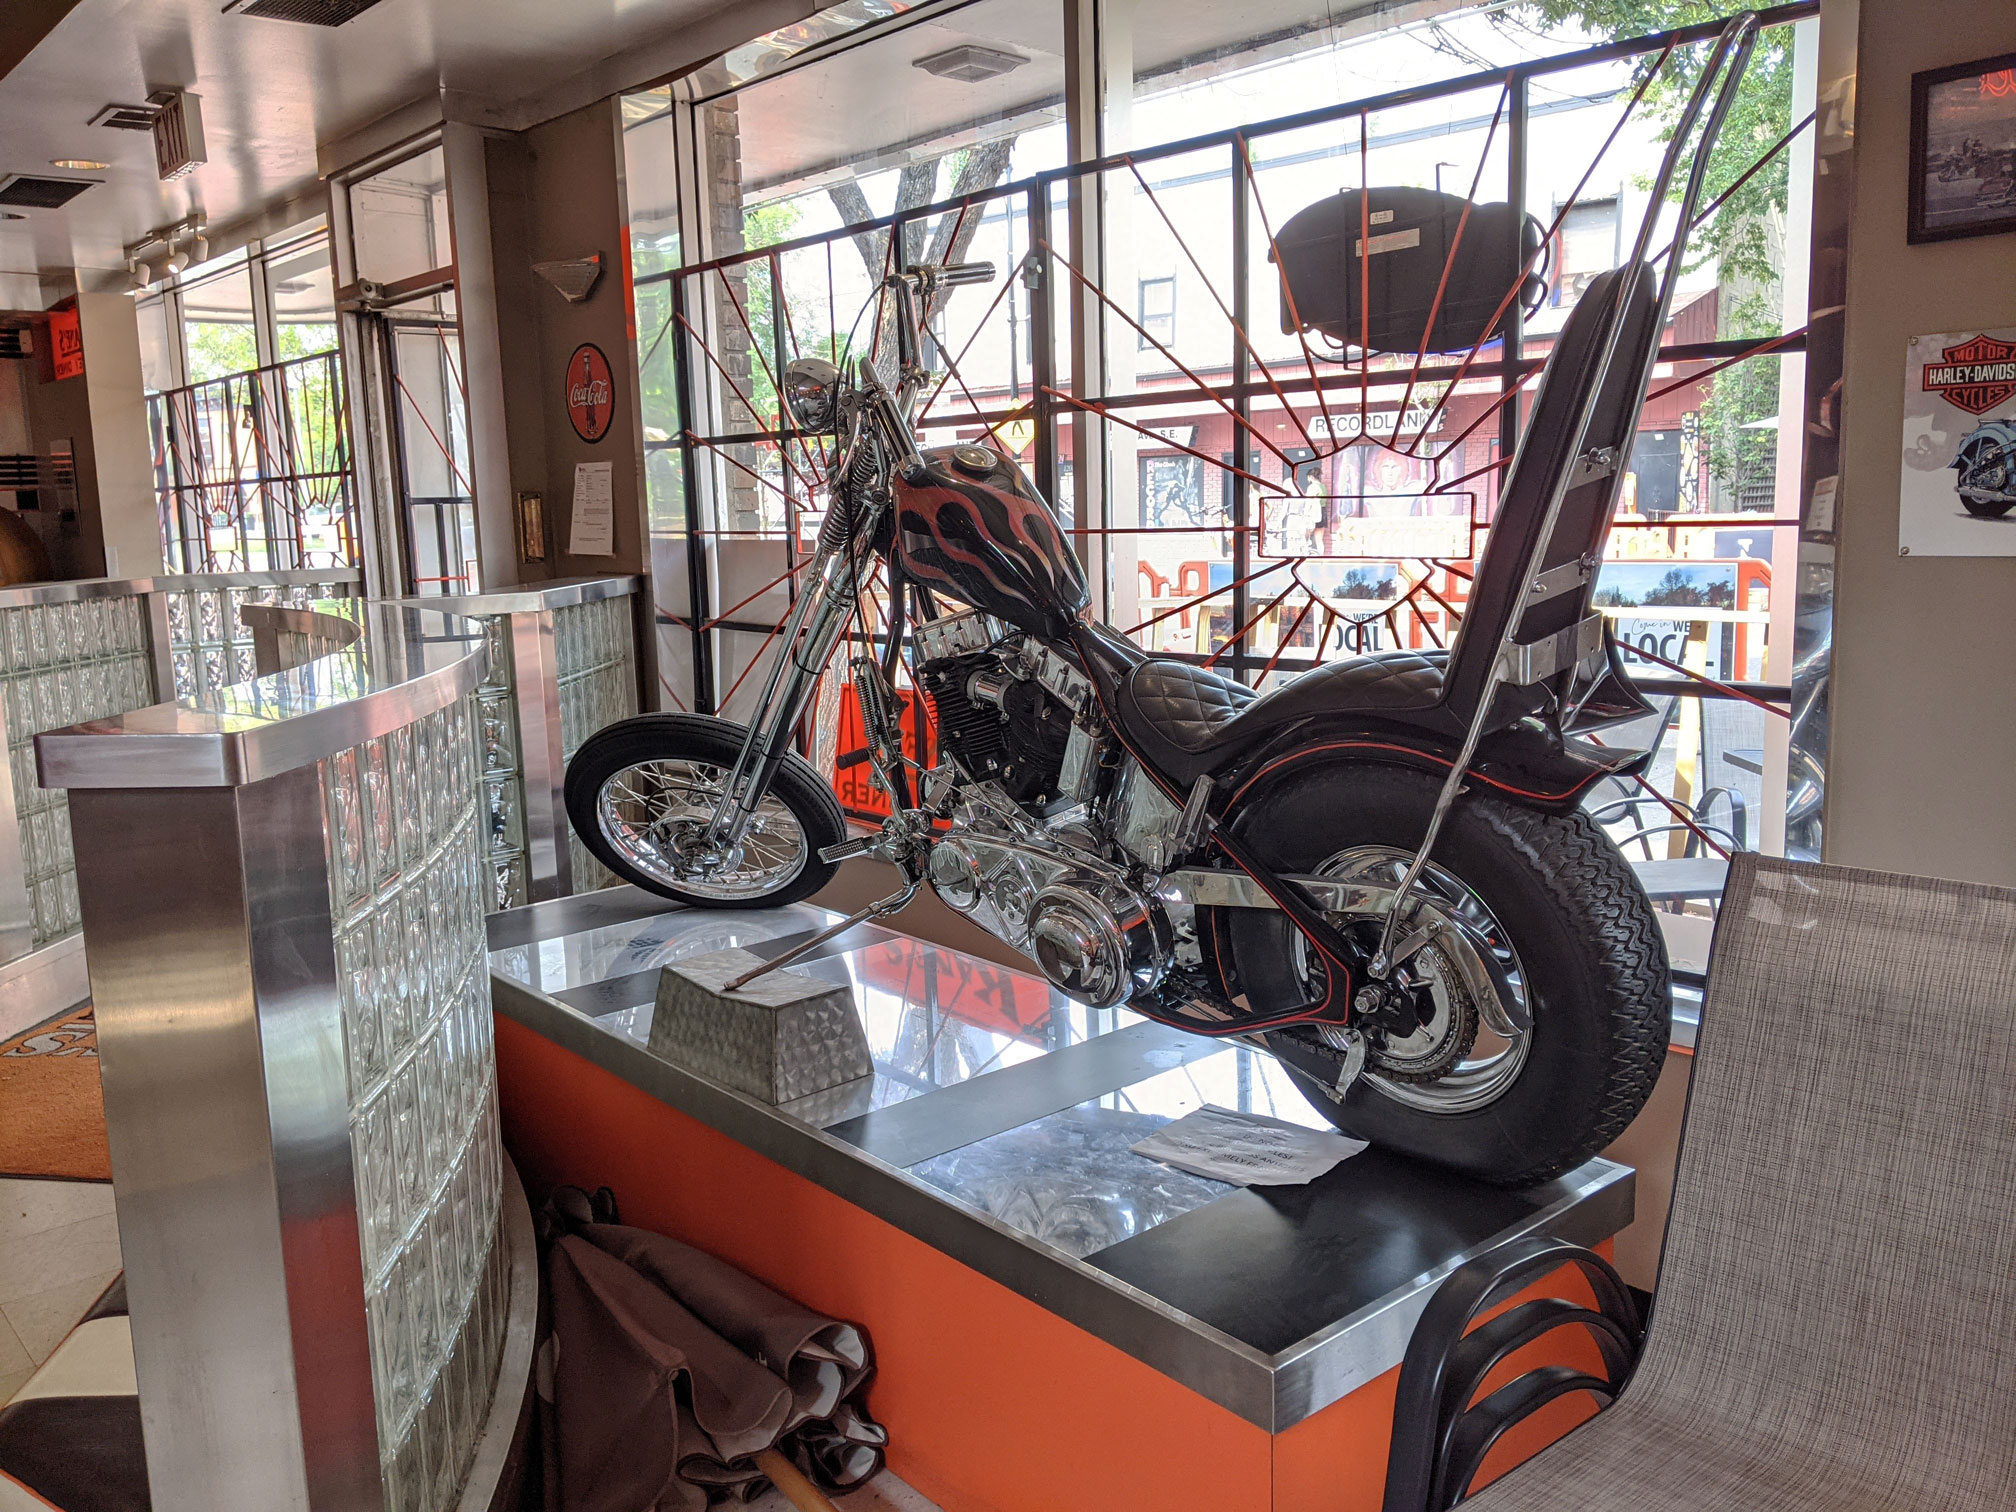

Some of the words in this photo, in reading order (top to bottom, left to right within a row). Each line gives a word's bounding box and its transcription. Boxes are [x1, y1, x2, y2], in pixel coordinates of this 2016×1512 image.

[155, 104, 184, 171] EXIT
[1953, 344, 2008, 362] MOTOR
[569, 379, 608, 408] Coca-Cola
[1953, 387, 2006, 408] CYCLES
